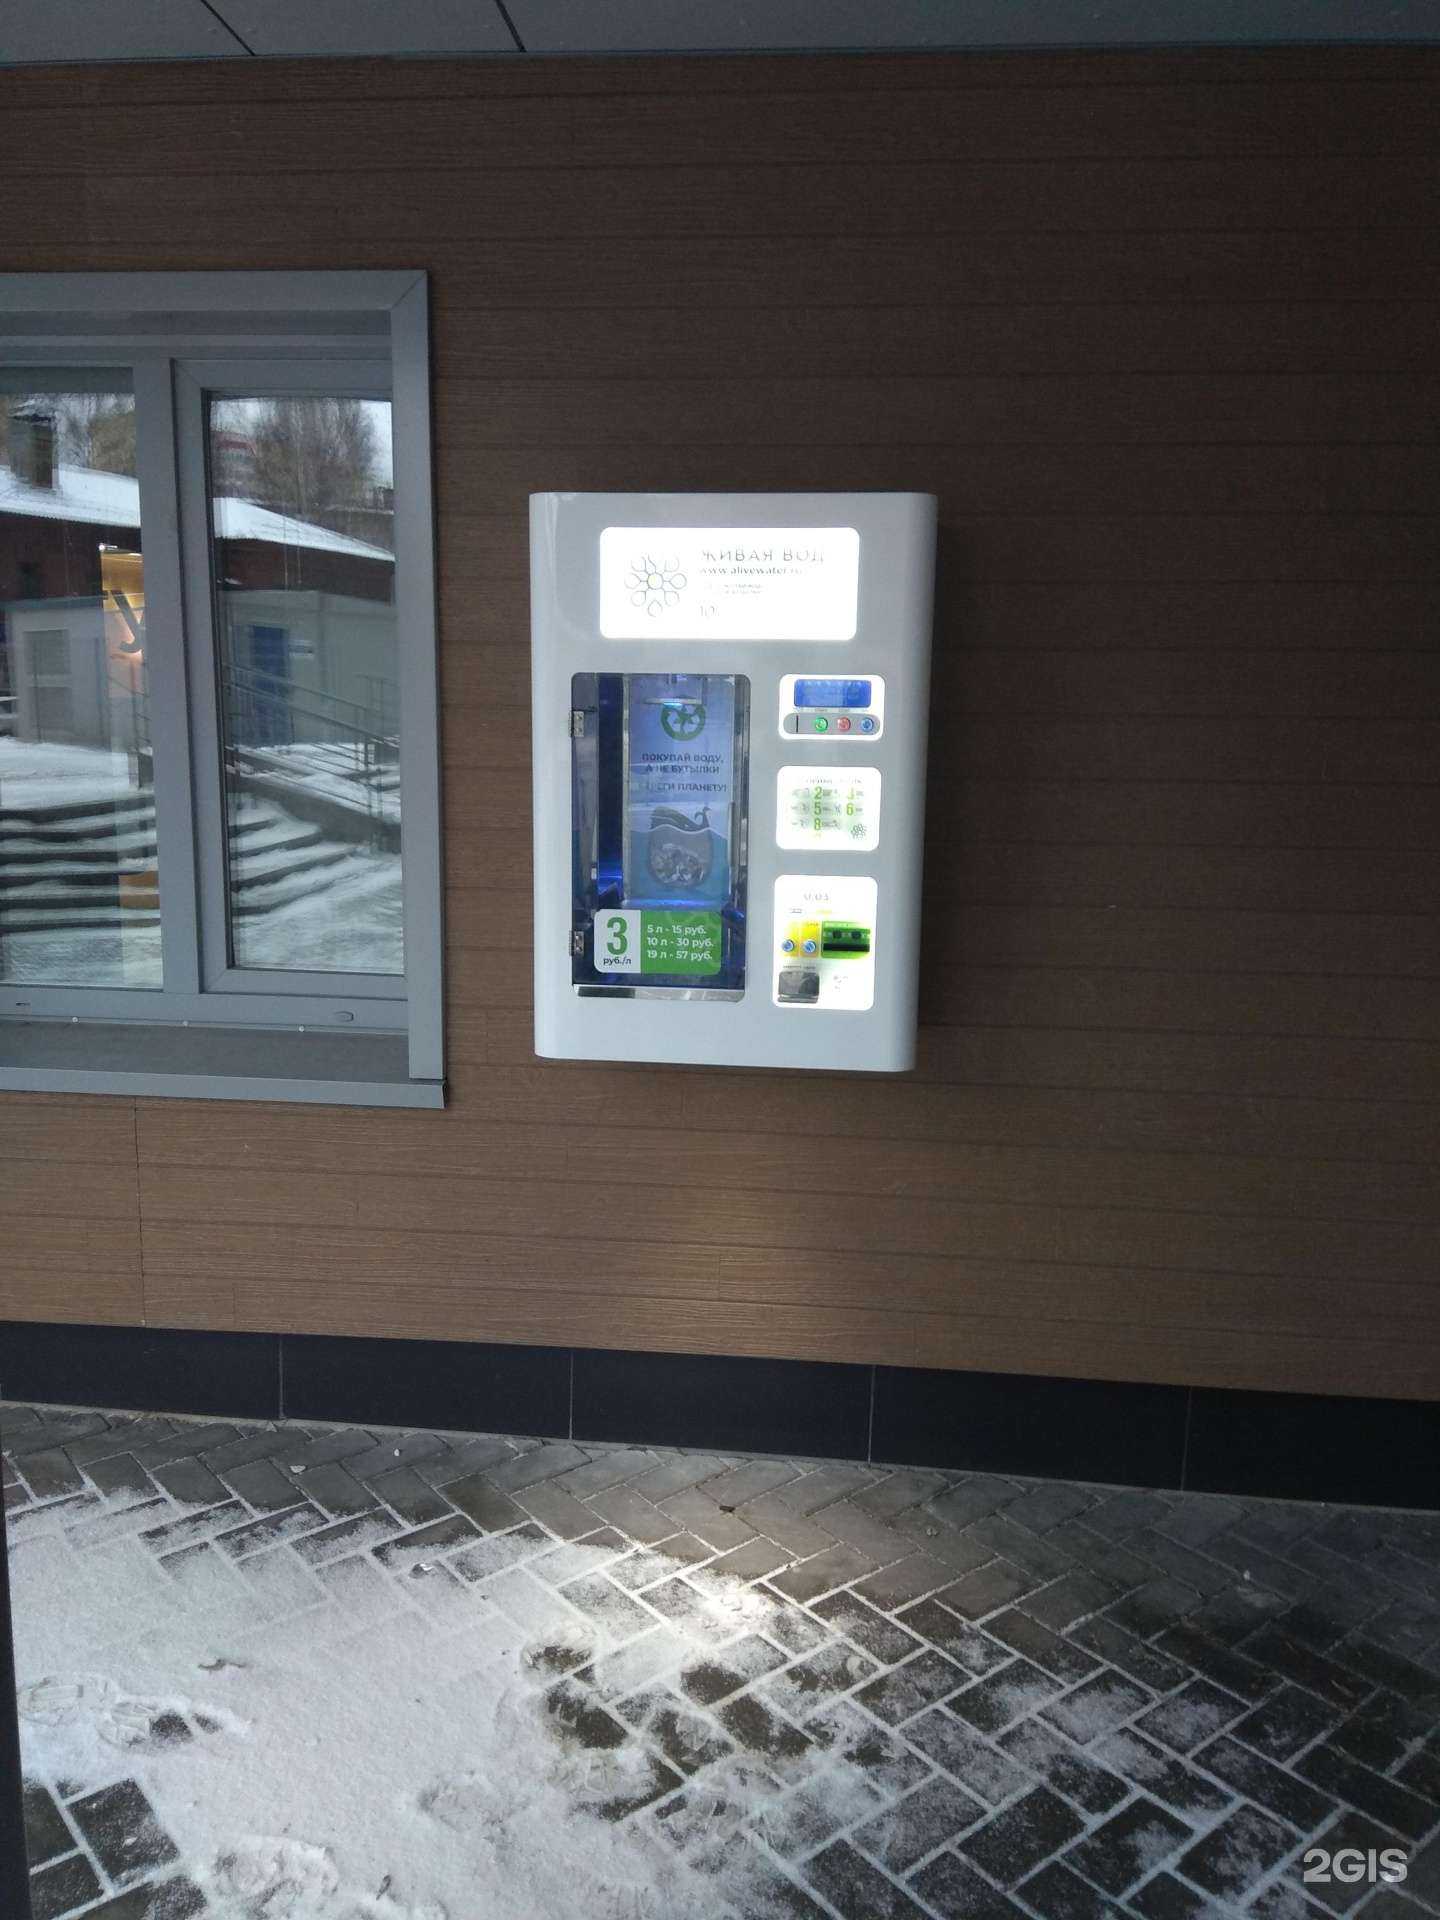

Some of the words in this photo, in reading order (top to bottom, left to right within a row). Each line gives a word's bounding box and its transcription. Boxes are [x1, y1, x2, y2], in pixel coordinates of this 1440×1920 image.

[700, 548, 773, 562] ЖИВАЯ
[783, 548, 826, 564] ВОД
[641, 751, 691, 762] ПОКУПАЙ
[671, 765, 720, 774] БУТЫЛКИ
[647, 924, 653, 933] 5
[672, 924, 682, 934] 15
[684, 924, 706, 936] руб.
[606, 916, 628, 956] 3
[647, 937, 657, 946] 10
[676, 937, 689, 946] 30
[692, 937, 714, 948] руб.
[603, 955, 632, 966] руб./л
[647, 950, 657, 959] 19
[660, 951, 667, 959] л
[676, 950, 688, 959] 57
[690, 950, 713, 961] руб.
